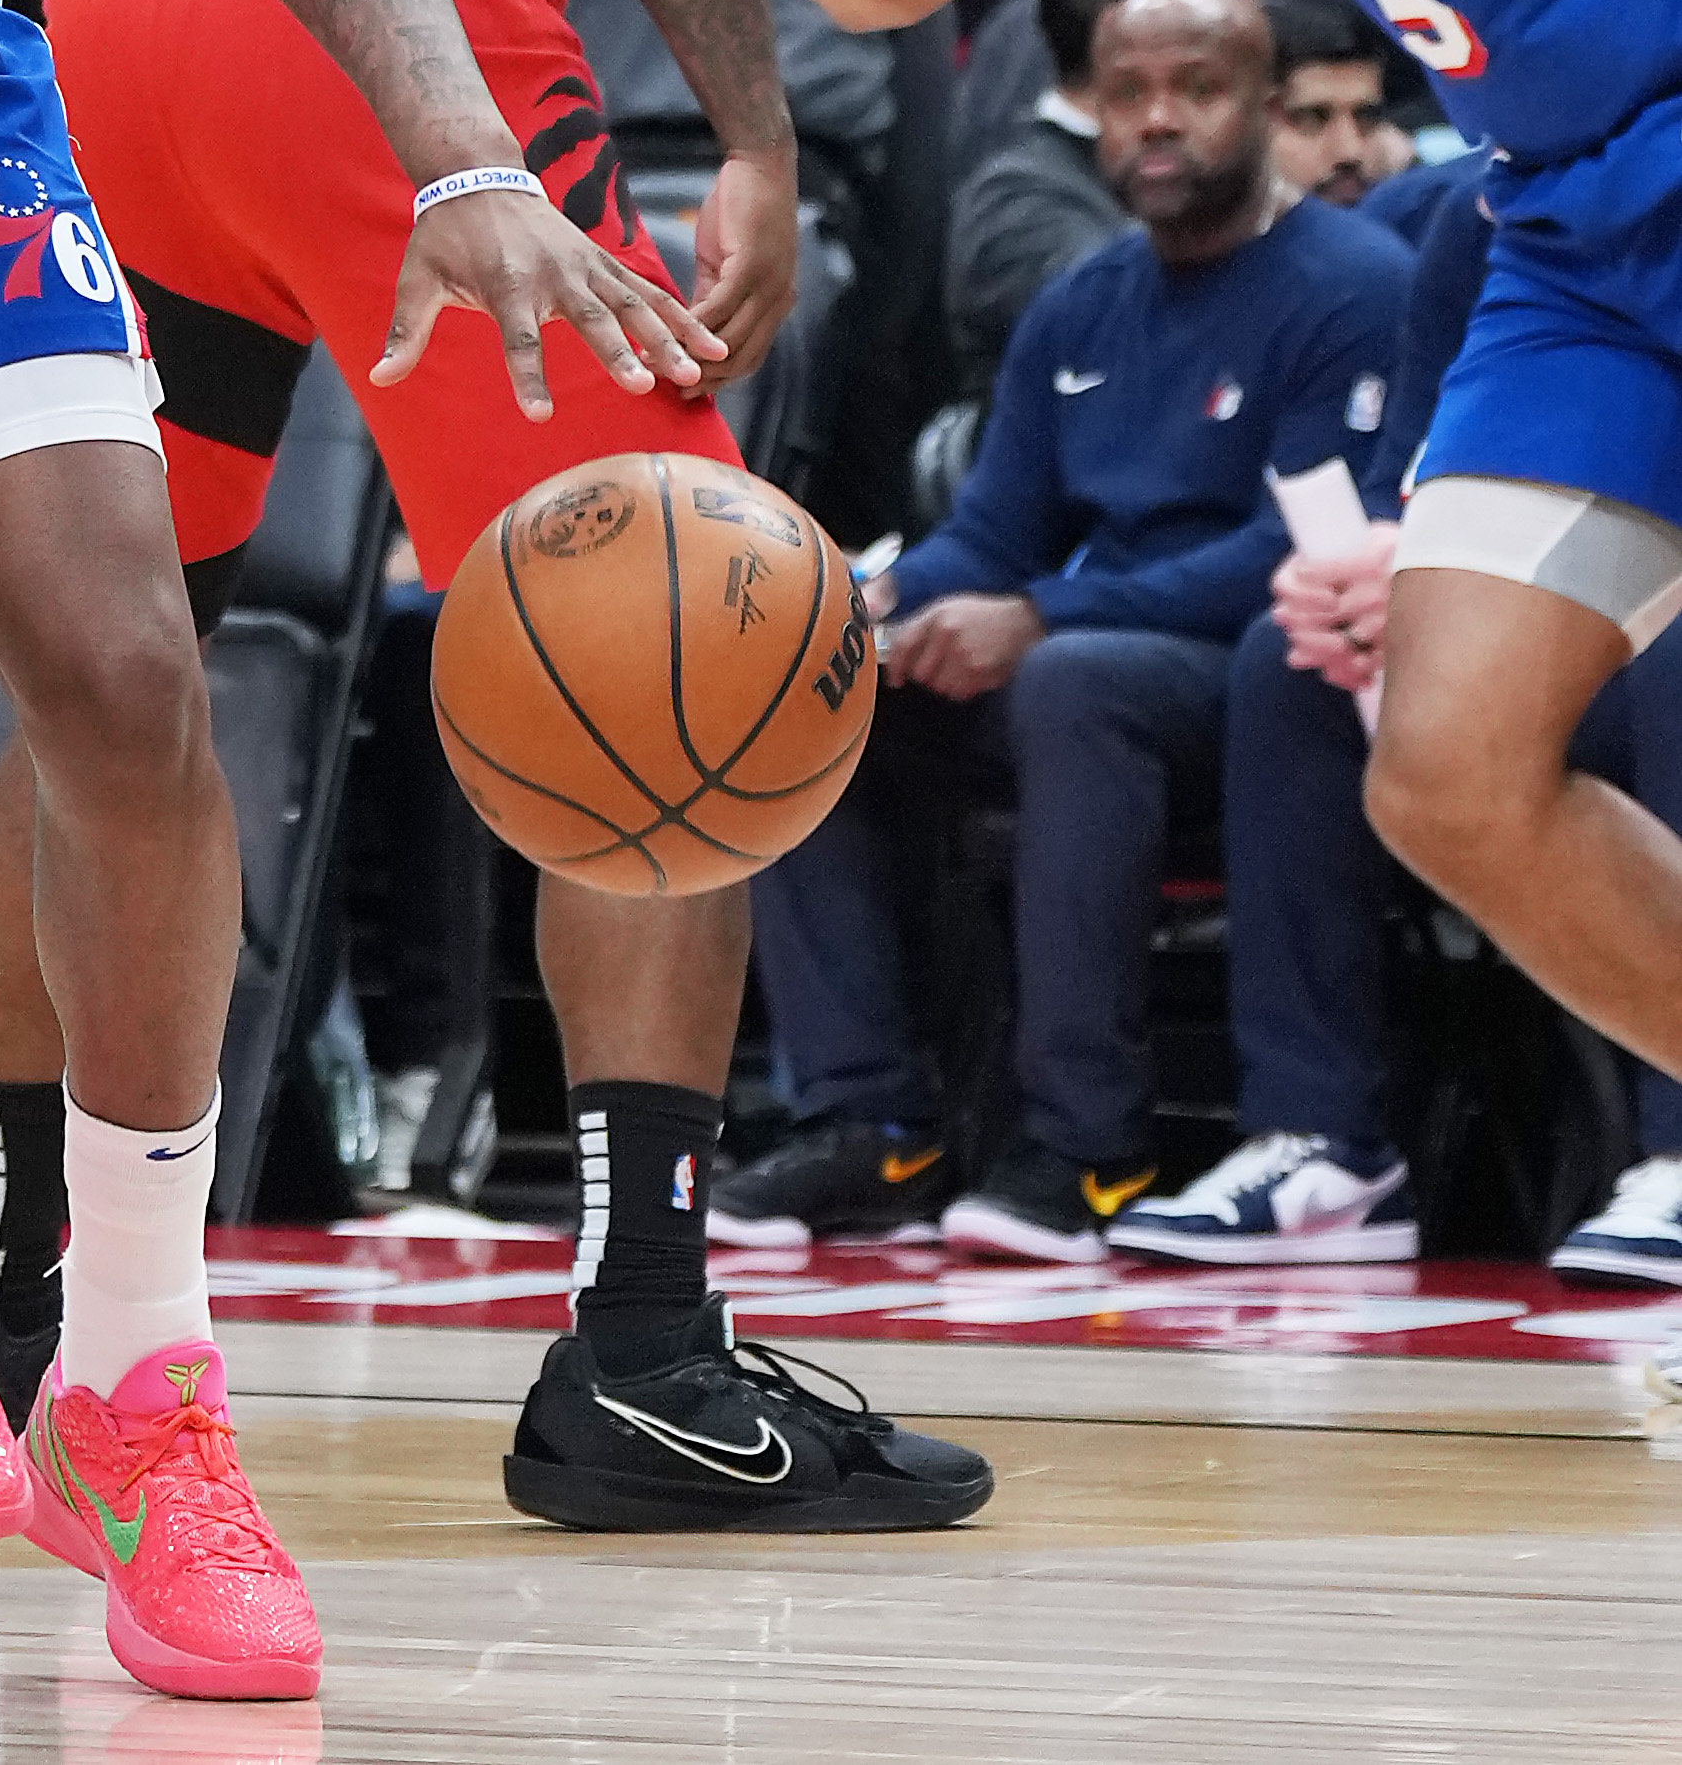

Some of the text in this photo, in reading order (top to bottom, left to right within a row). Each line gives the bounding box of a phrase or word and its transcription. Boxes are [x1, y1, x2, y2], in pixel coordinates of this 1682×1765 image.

[418, 172, 528, 206] EXPECT TO WIN
